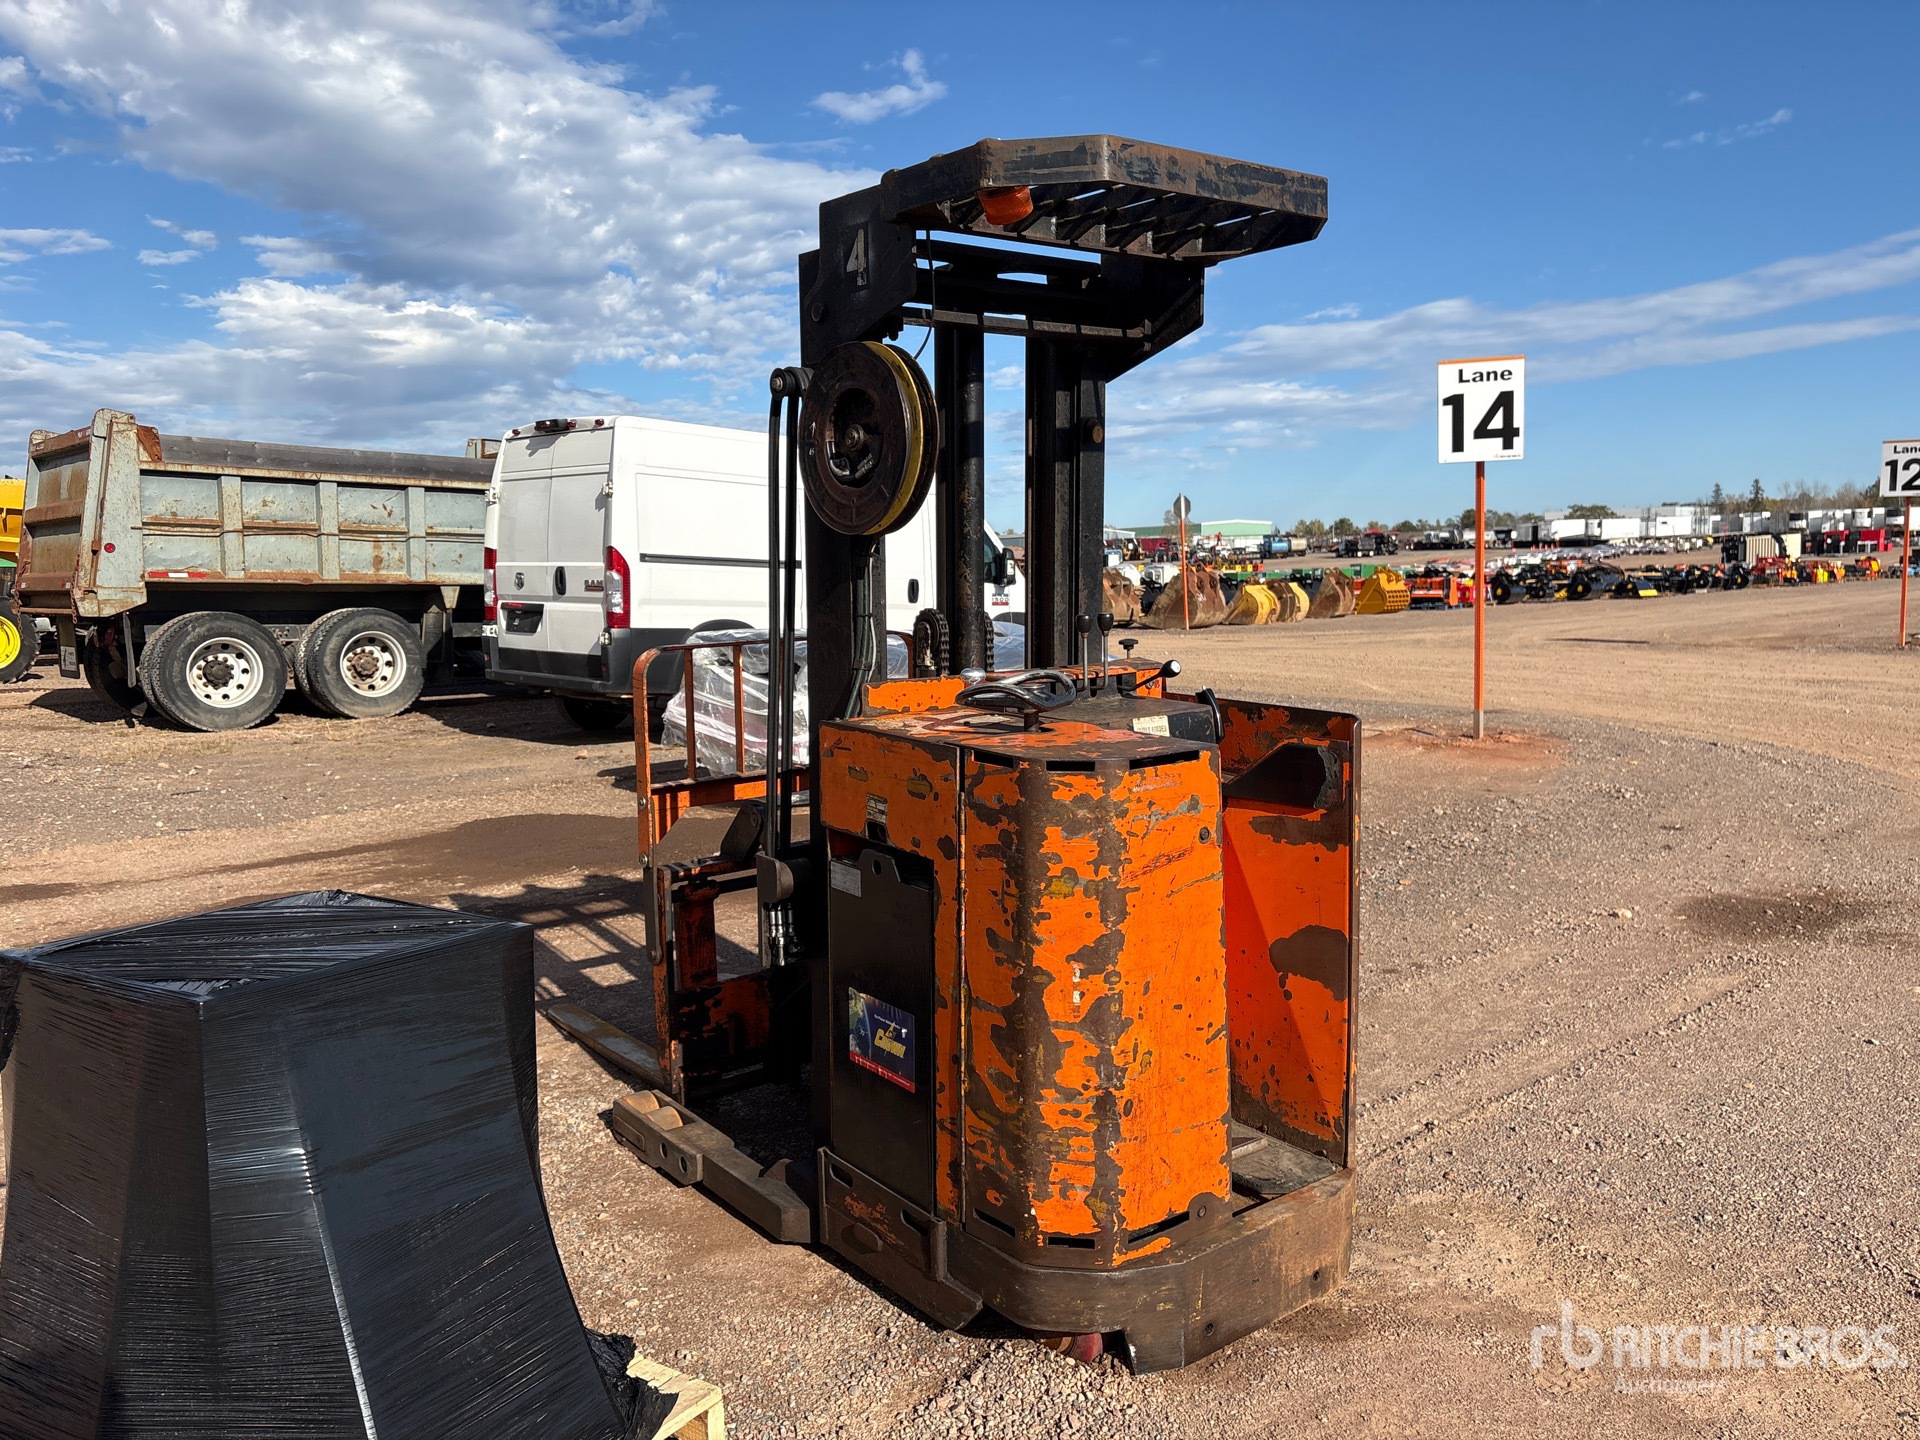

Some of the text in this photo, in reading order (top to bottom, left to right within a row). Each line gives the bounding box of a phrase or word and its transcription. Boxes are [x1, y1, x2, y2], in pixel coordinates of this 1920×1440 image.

[846, 228, 867, 286] 4
[1458, 368, 1513, 383] Lane
[1442, 390, 1520, 453] 14
[1885, 458, 1920, 491] 12
